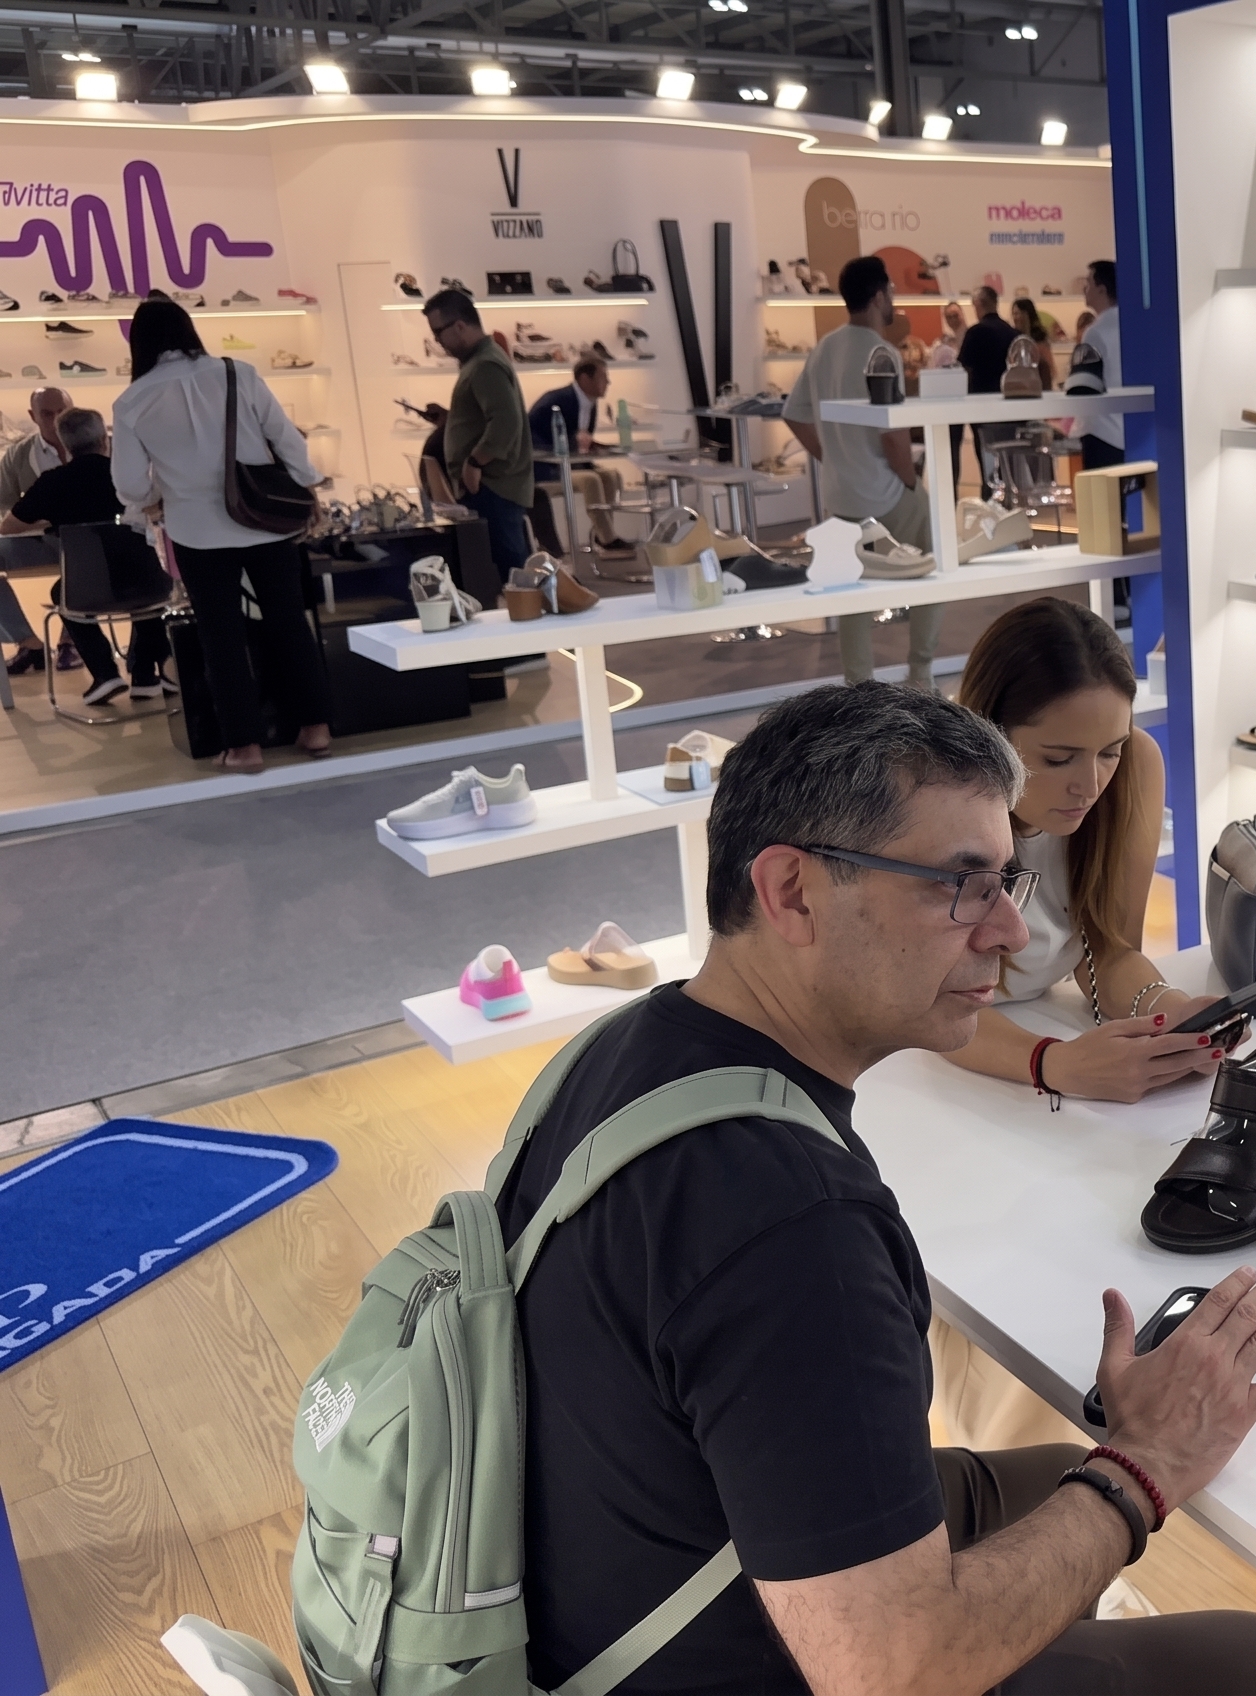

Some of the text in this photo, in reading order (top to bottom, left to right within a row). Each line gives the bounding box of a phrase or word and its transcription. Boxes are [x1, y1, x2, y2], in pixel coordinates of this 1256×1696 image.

[890, 204, 921, 232] rio
[987, 199, 1063, 222] moleca
[491, 219, 544, 239] VIZZANO
[0, 1247, 182, 1358] GADA
[309, 1376, 341, 1427] NORTH
[335, 1381, 357, 1412] THE
[301, 1402, 328, 1440] FACE
